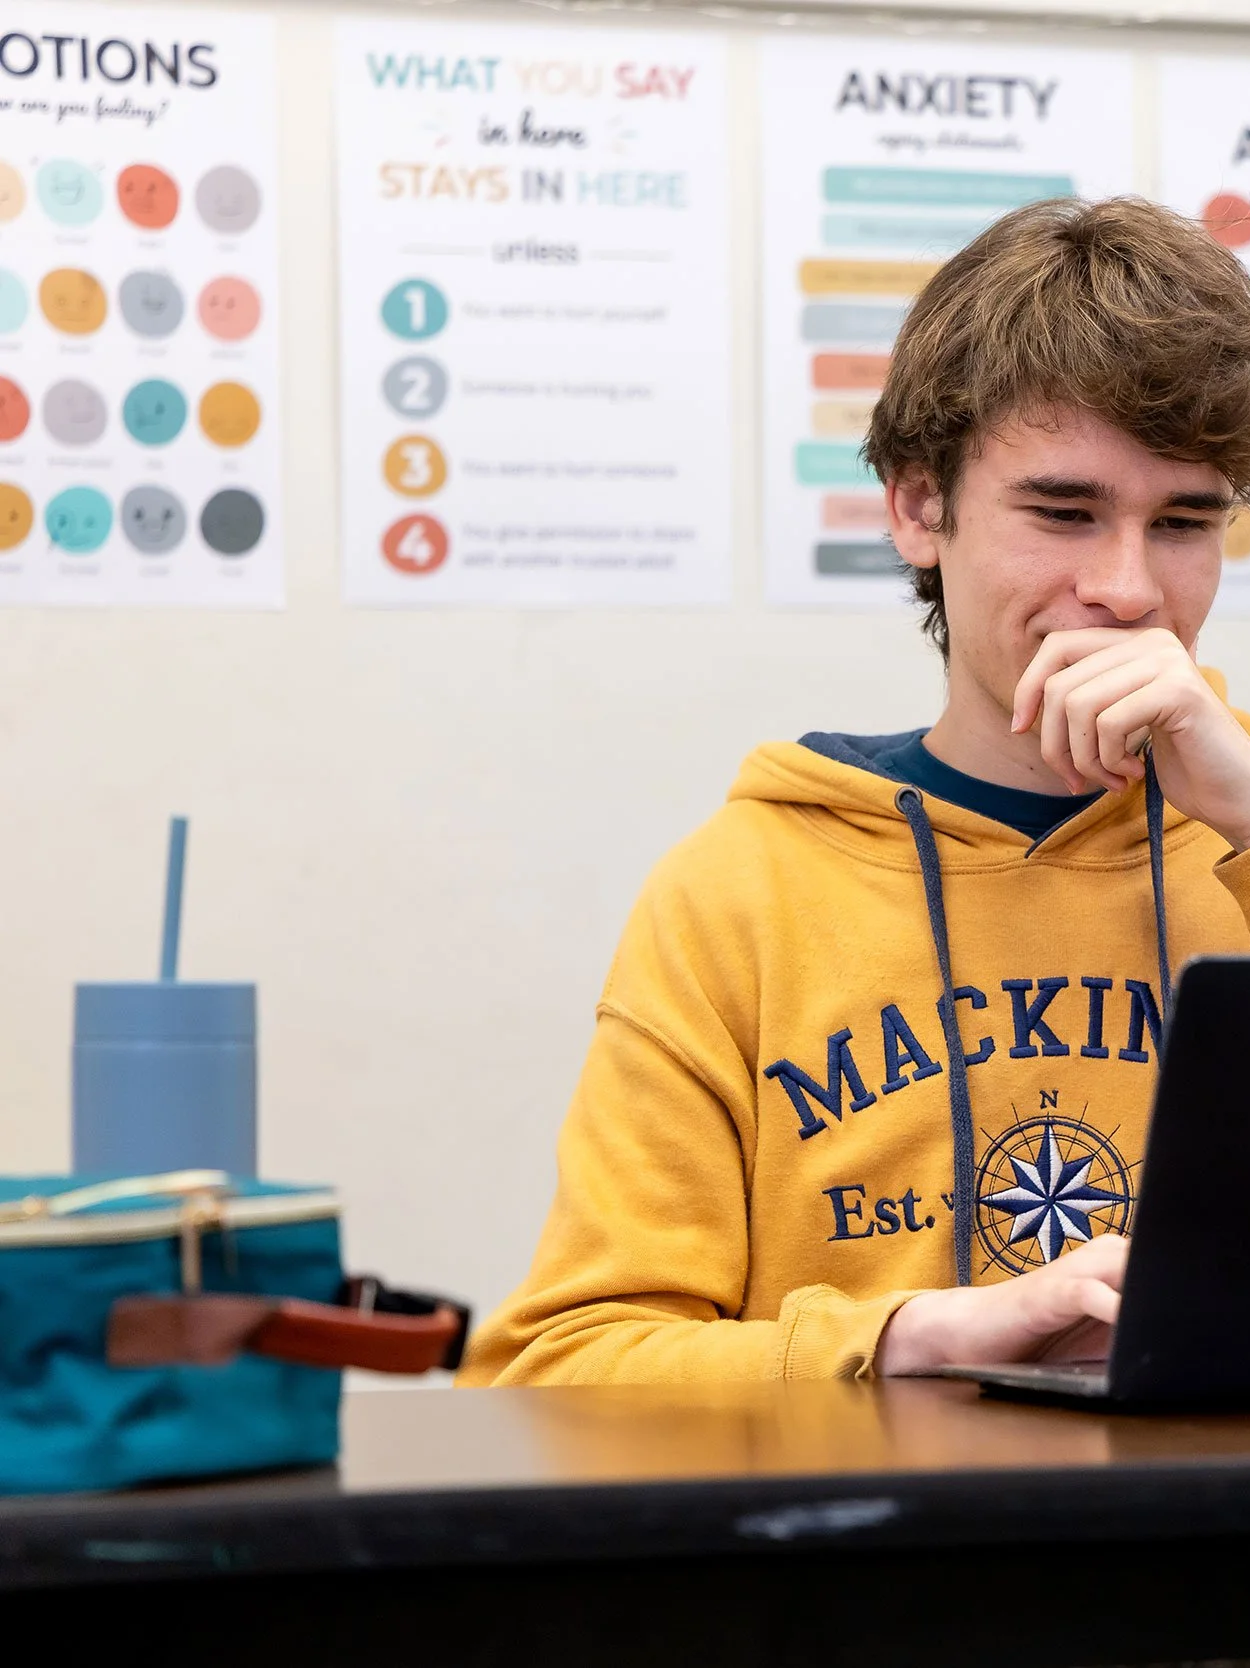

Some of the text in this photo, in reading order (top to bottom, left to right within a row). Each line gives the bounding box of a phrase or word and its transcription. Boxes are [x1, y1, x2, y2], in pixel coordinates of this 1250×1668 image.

[366, 52, 695, 99] WHAT YOU SAY
[835, 67, 1060, 121] ANXIETY
[477, 104, 588, 147] in here
[378, 160, 690, 209] STAYS IN HERE
[490, 236, 583, 265] unless
[403, 287, 427, 332] 1
[400, 365, 432, 410] 2
[401, 442, 432, 489] 3
[396, 521, 435, 567] 4
[1039, 1090, 1059, 1110] N
[822, 1183, 936, 1242] Est.
